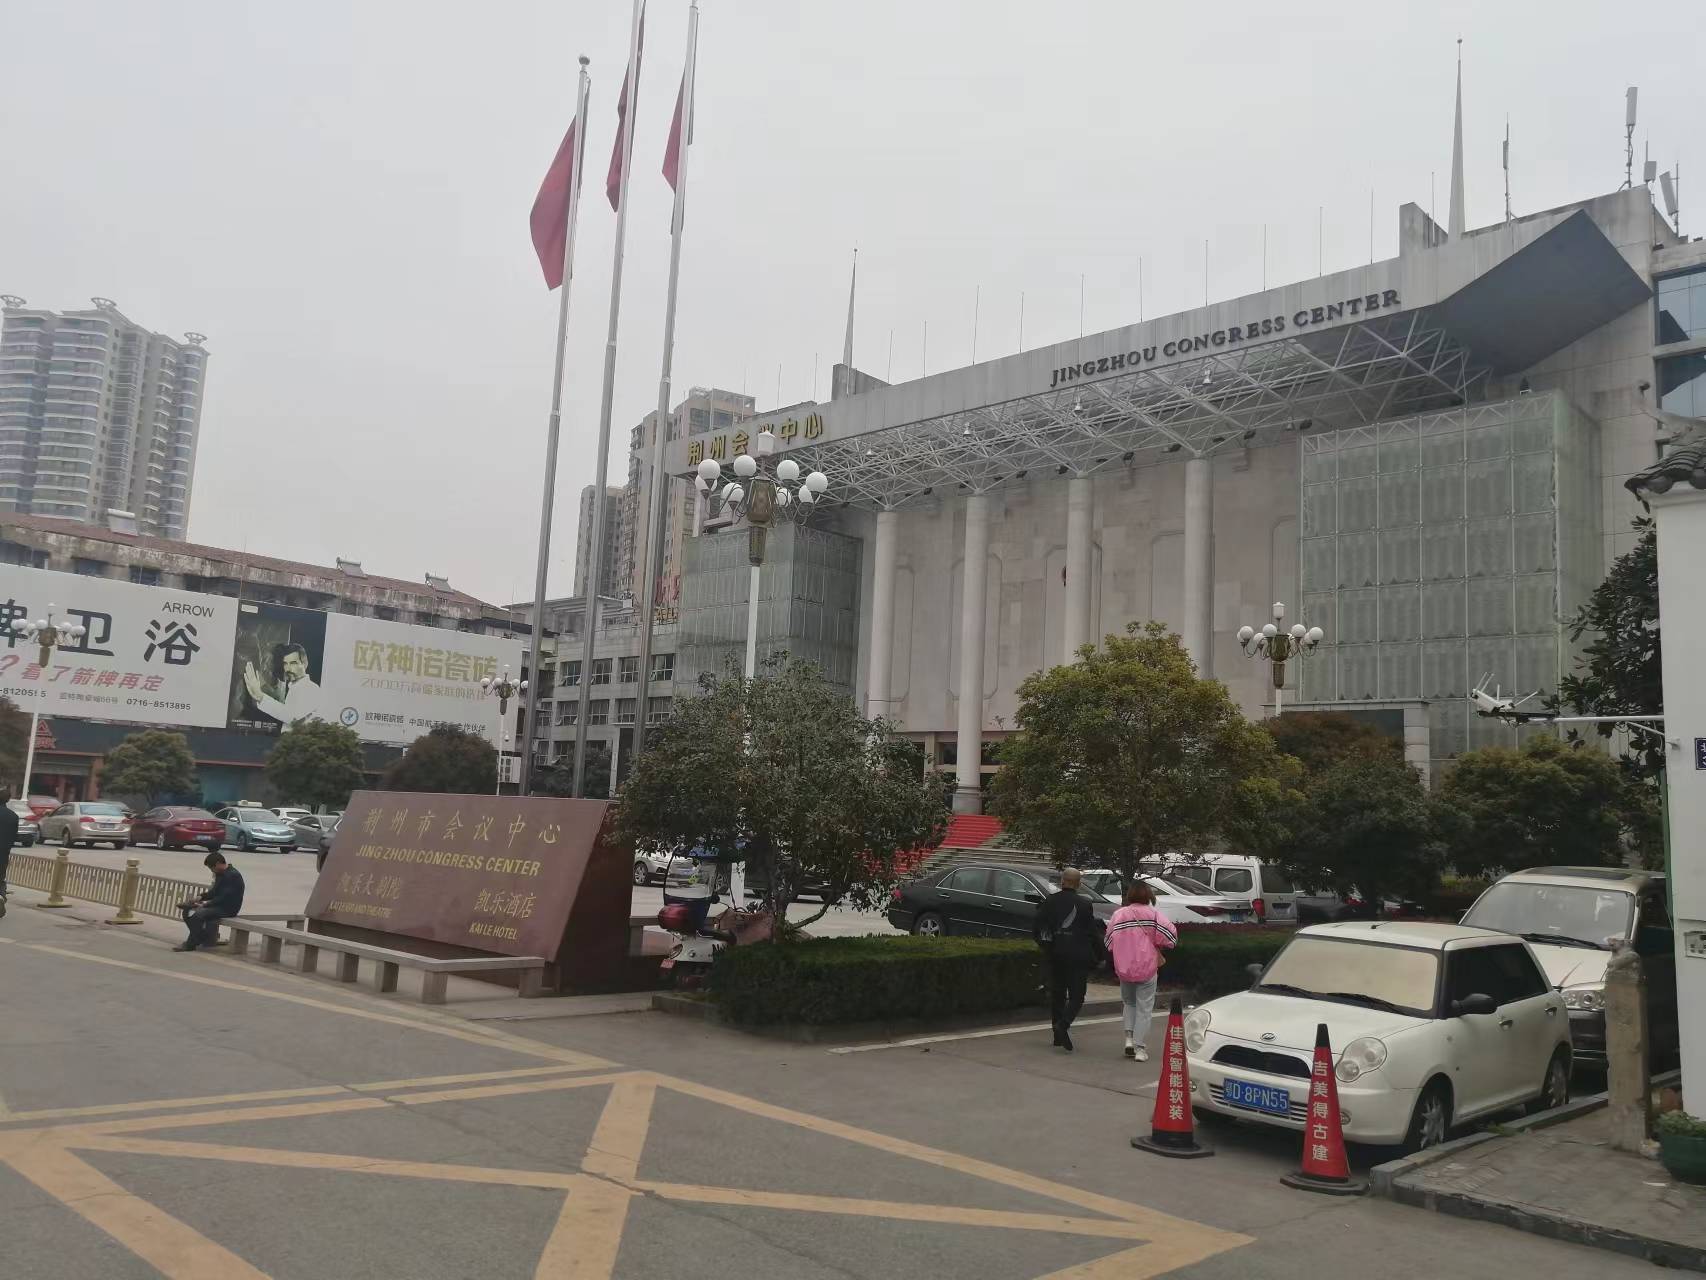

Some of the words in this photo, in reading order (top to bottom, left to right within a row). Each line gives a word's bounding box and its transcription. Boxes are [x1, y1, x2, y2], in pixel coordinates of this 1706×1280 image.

[1050, 346, 1157, 387] JINGZHOU
[1162, 314, 1286, 358] CONGRESS
[1292, 288, 1402, 327] CENTER
[162, 601, 215, 618] ARROW
[353, 640, 498, 682] 欧神诺瓷砖
[126, 698, 191, 710] 0716-8513895
[356, 844, 383, 860] JING
[383, 847, 416, 863] ZHOU
[417, 850, 483, 871] CONGRESS
[485, 857, 542, 877] CENTER
[473, 888, 536, 919] 凯乐酒店
[492, 925, 518, 941] HOTEL
[1168, 1025, 1184, 1120] 佳美智能软装
[1312, 1060, 1329, 1162] 吉美得古建
